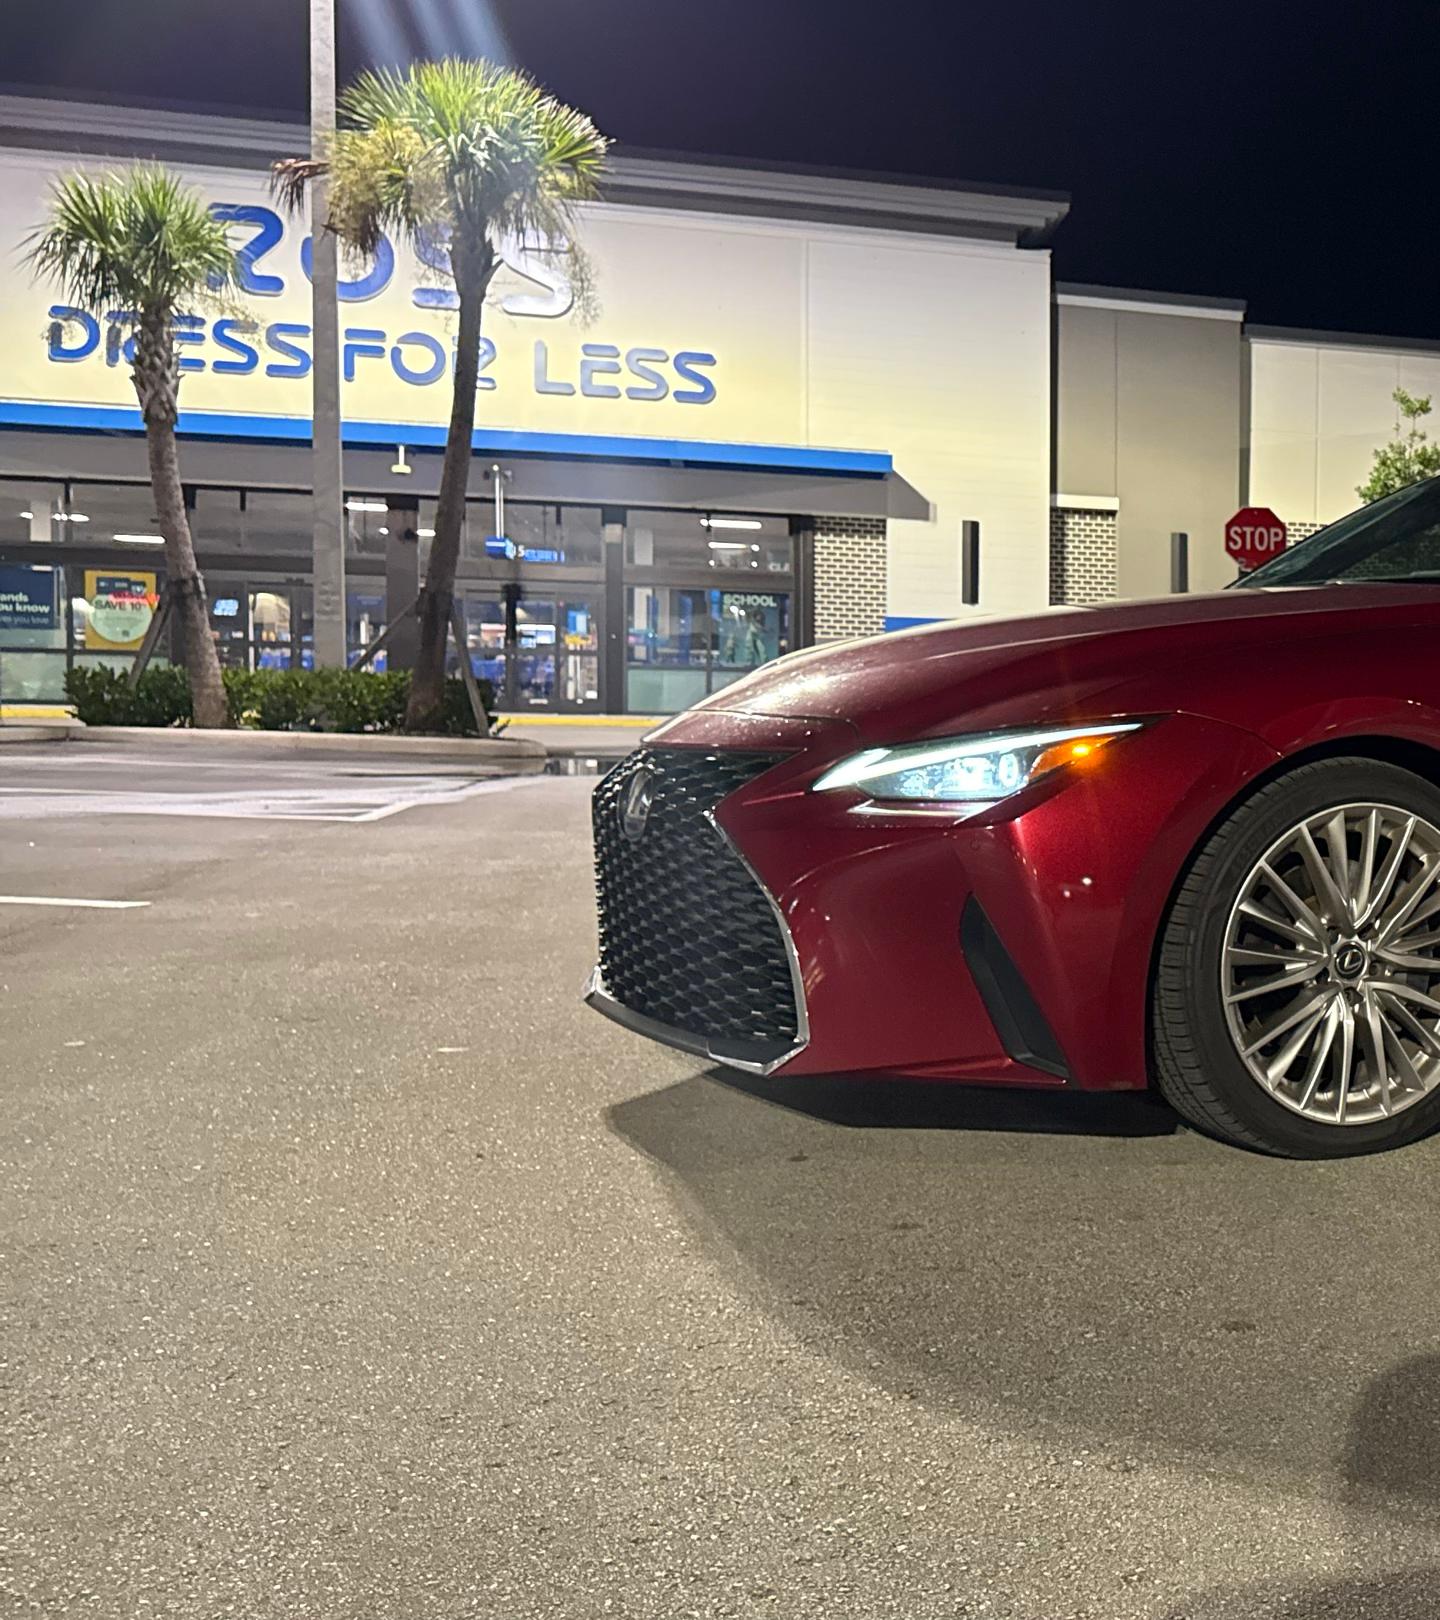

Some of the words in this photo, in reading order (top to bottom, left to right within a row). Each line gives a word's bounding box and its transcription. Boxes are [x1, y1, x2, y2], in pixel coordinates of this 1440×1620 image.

[534, 339, 716, 404] LESS
[1228, 525, 1284, 551] STOP
[94, 599, 126, 611] SAVE
[723, 593, 777, 607] SCHOOL
[15, 602, 51, 614] know
